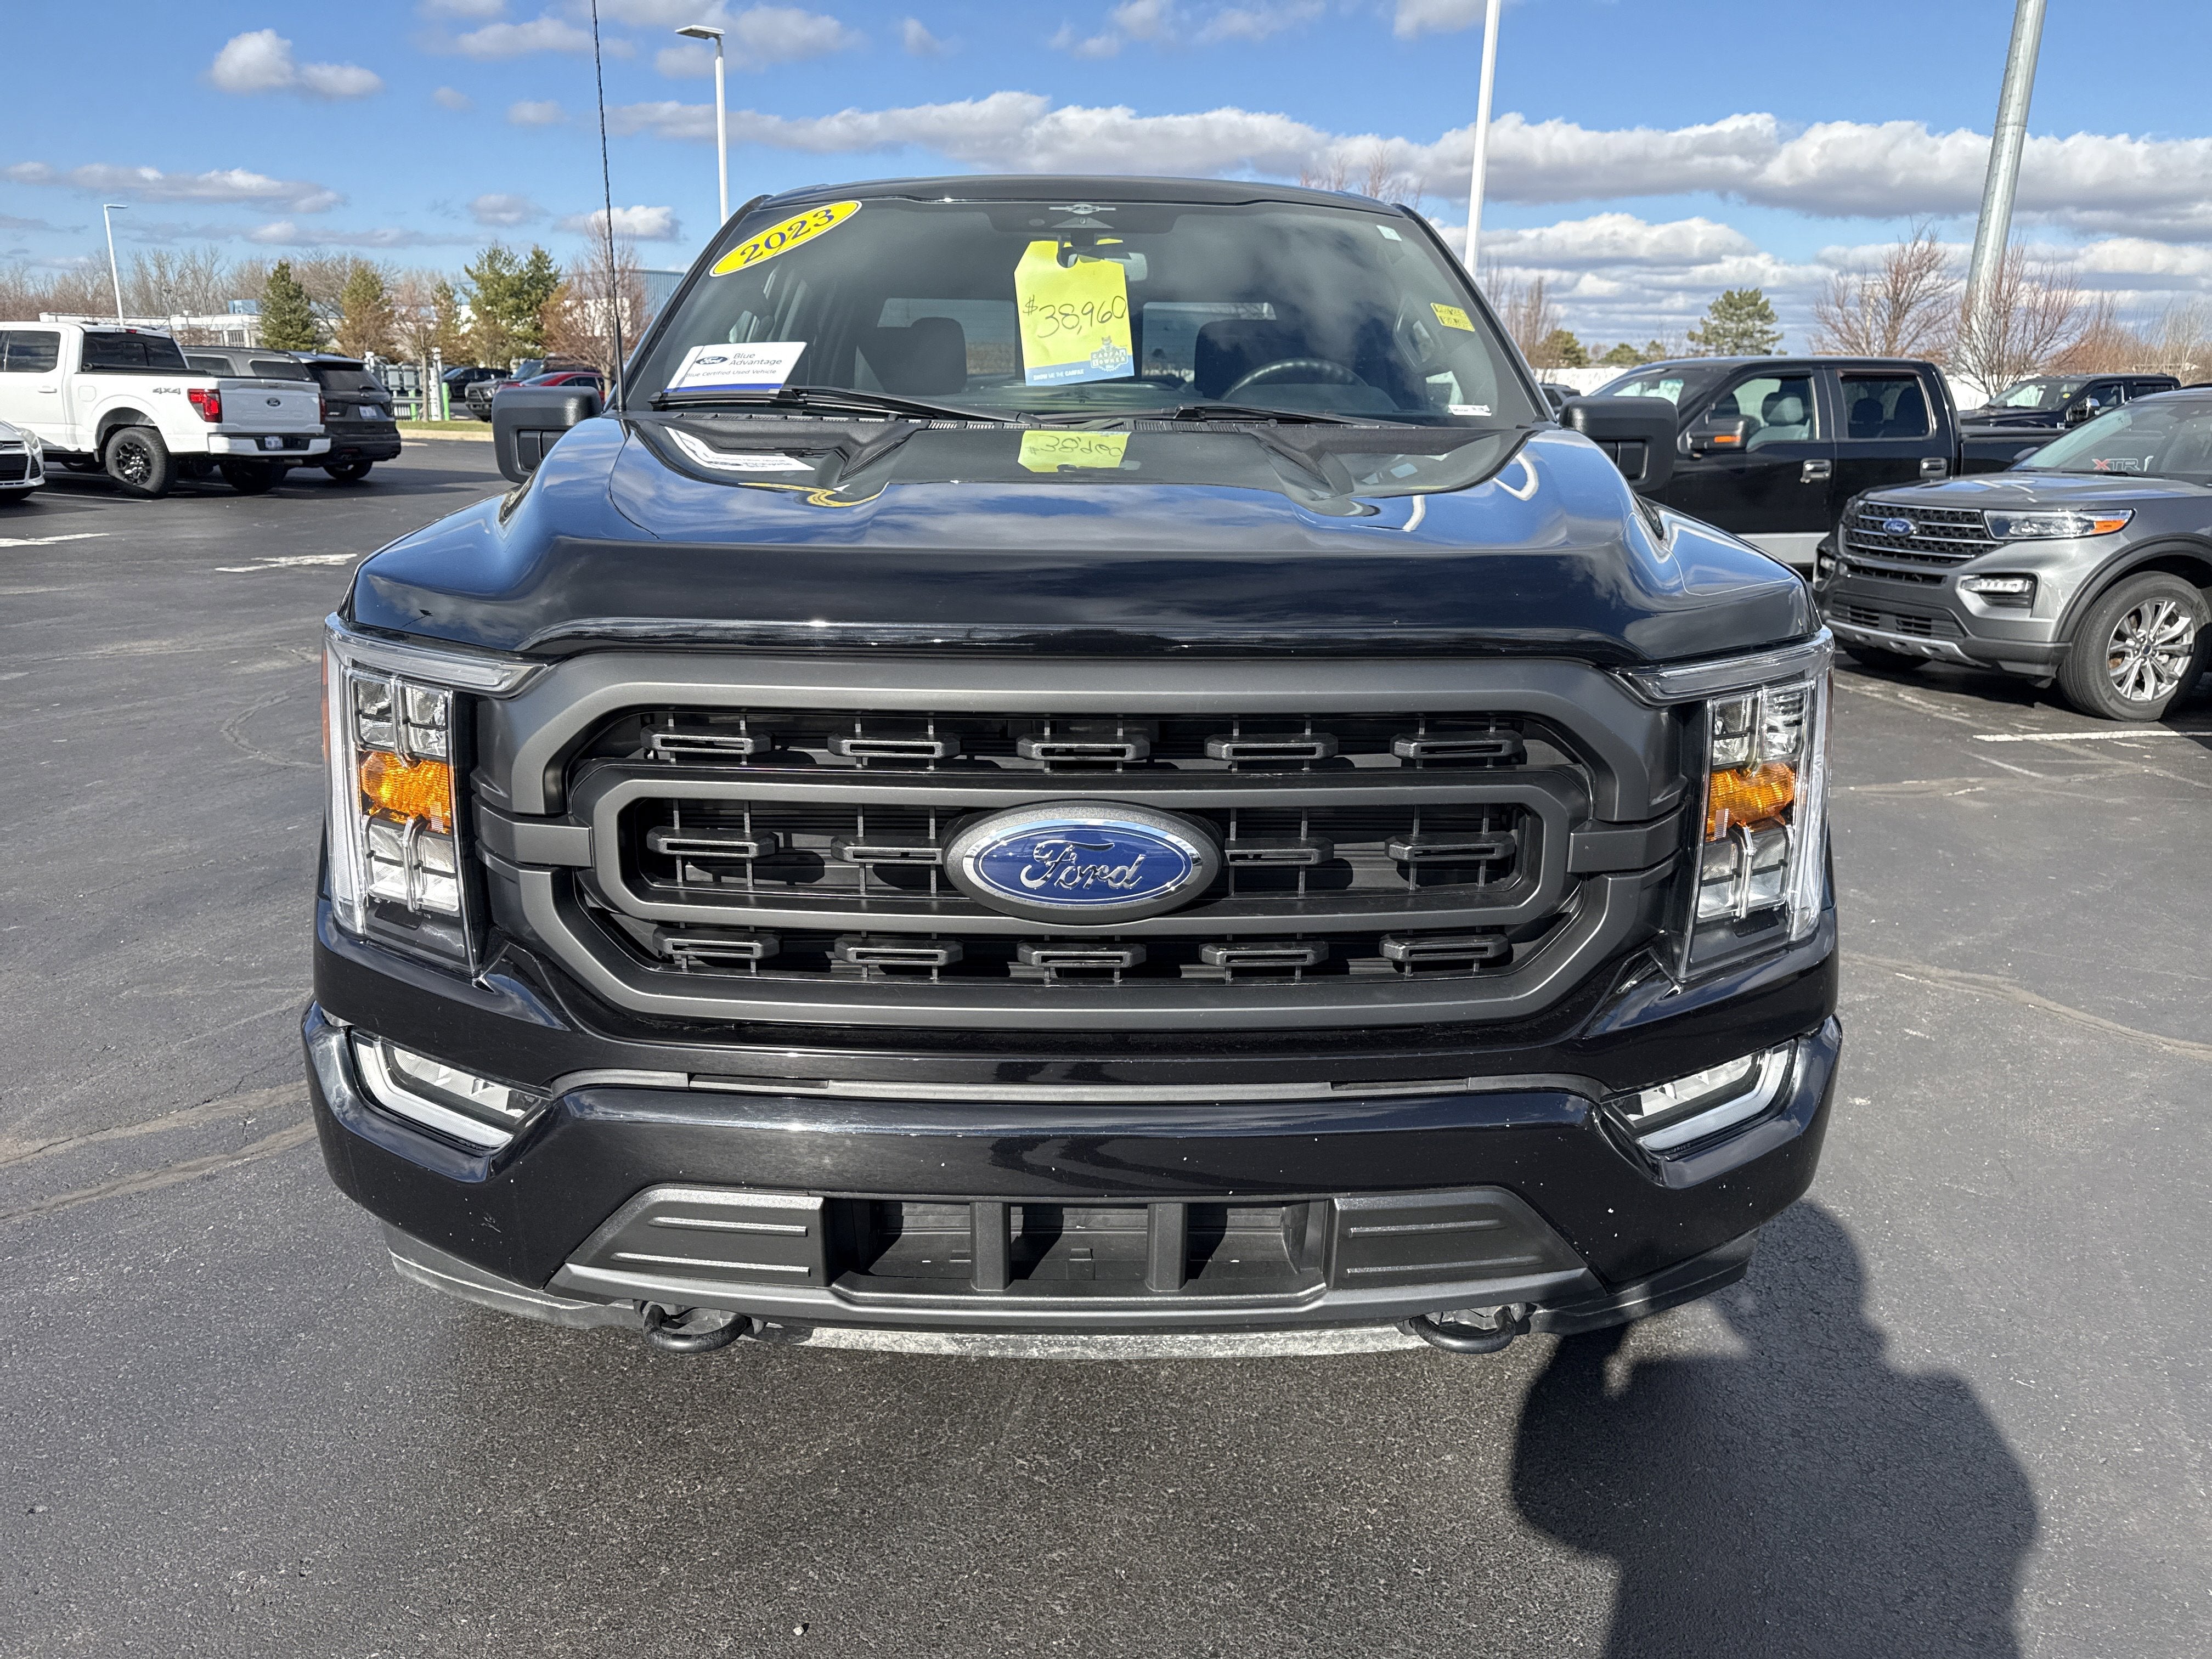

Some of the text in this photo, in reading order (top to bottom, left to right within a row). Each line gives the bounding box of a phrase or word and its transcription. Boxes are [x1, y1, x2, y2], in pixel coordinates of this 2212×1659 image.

[740, 208, 835, 265] 2023
[1022, 294, 1127, 338] $38,960
[2091, 458, 2141, 471] XTR
[1019, 839, 1146, 890] Ford
